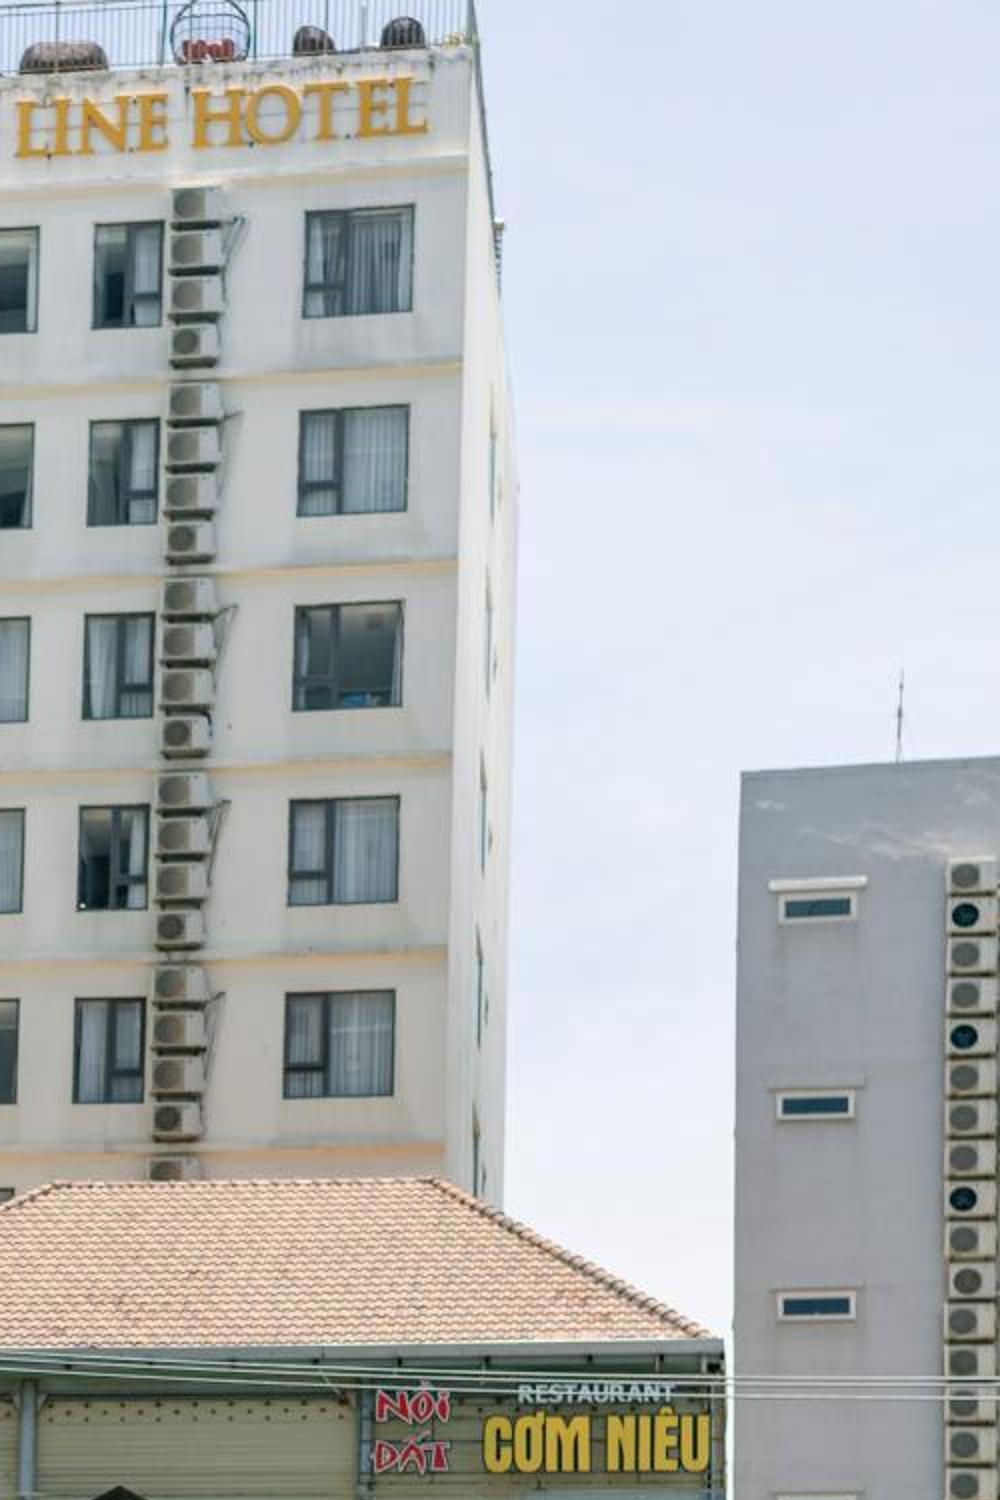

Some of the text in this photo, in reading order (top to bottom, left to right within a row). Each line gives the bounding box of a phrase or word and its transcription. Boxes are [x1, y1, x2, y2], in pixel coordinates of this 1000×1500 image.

[14, 92, 169, 160] LINE
[191, 76, 429, 150] HOTEL
[517, 1383, 677, 1404] RESTAURANT
[483, 1404, 710, 1474] CƠM NIÊU
